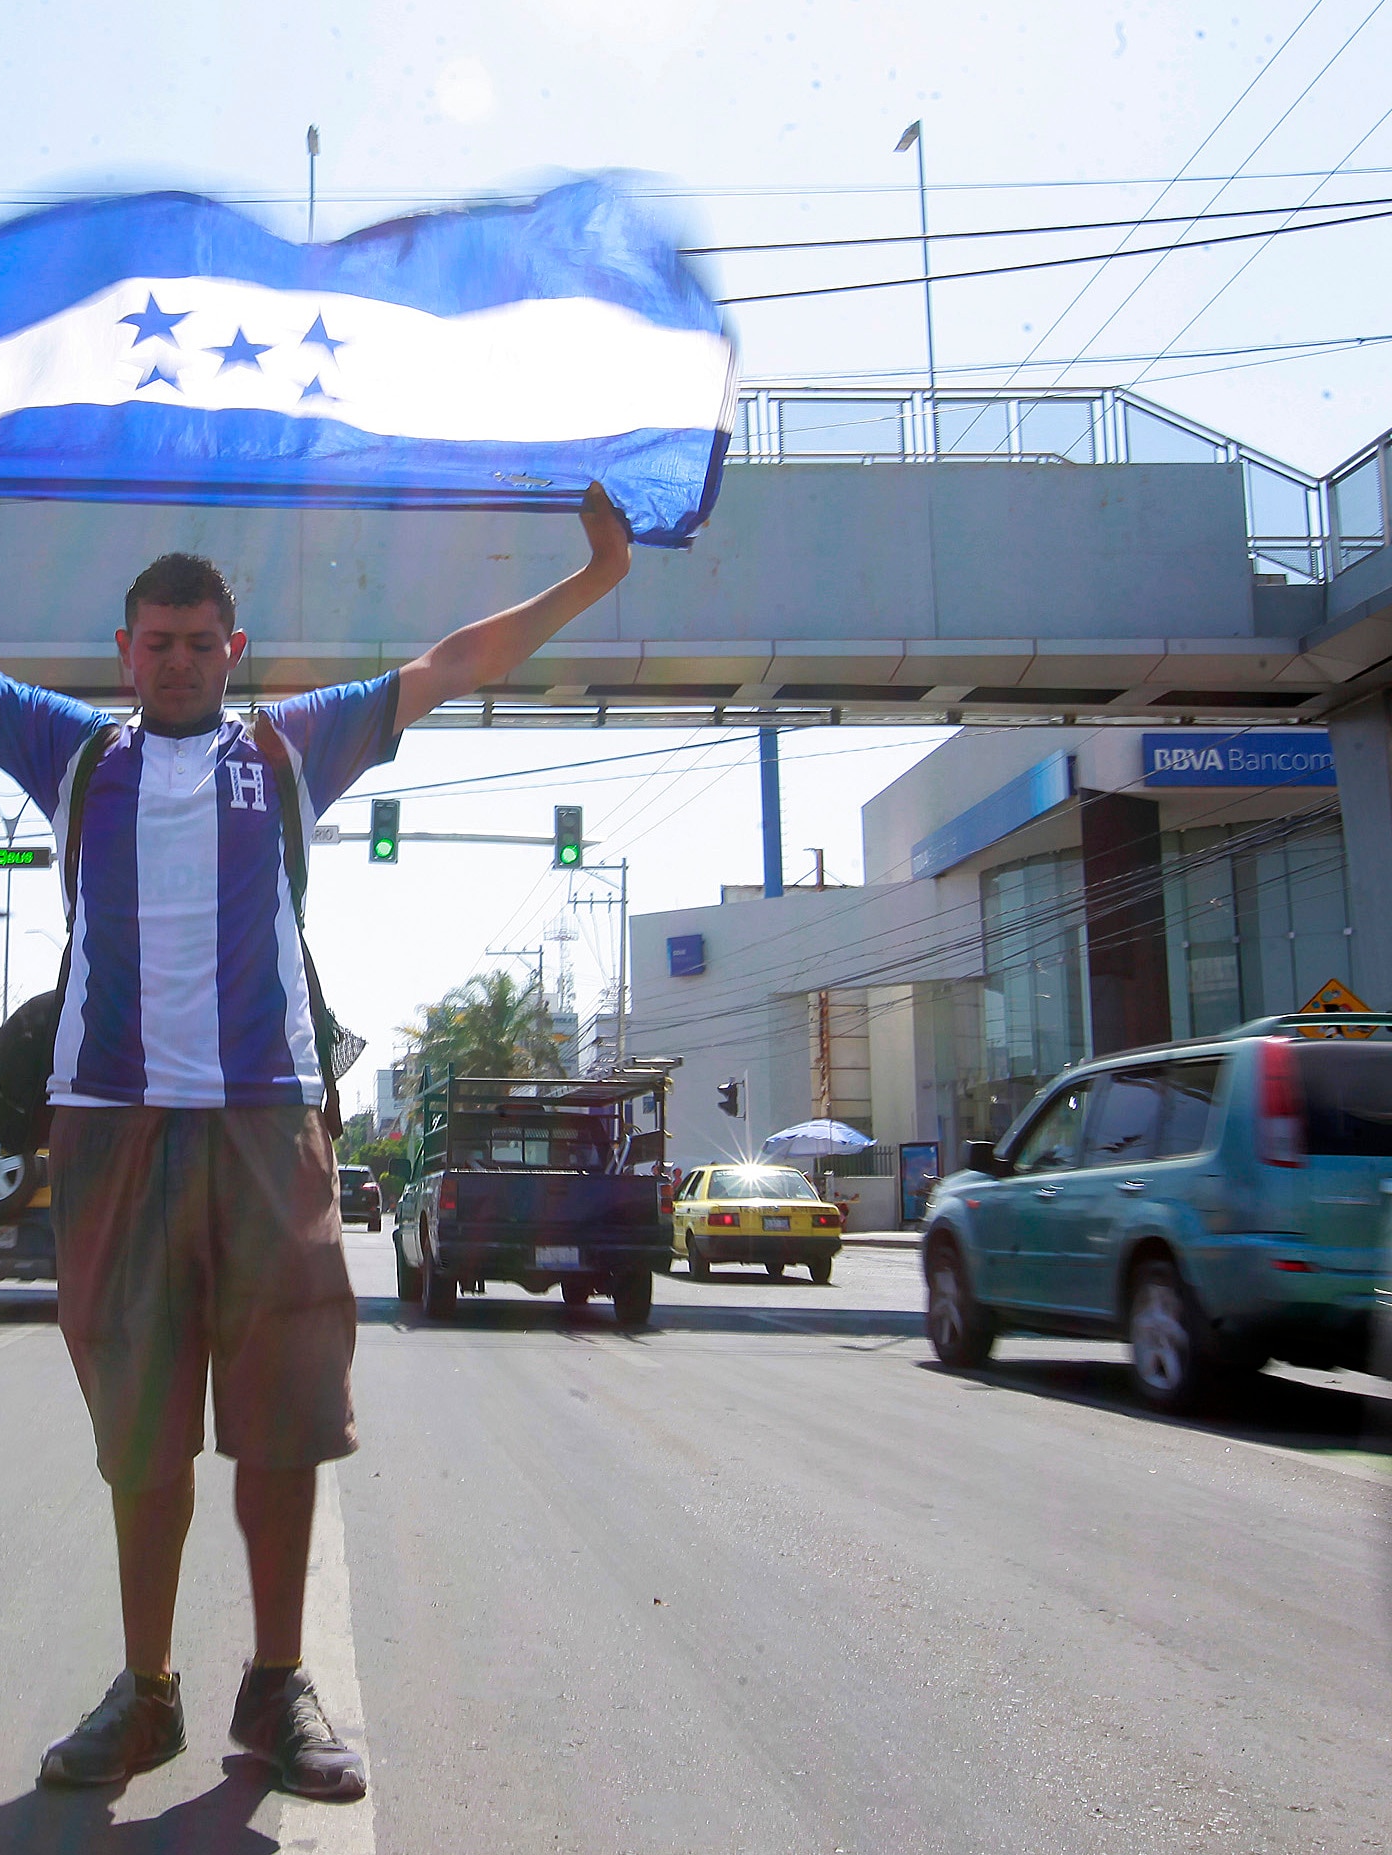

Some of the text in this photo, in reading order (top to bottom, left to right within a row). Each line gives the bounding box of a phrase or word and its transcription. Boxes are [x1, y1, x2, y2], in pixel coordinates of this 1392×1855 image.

[1154, 748, 1335, 771] BBVA Bancom
[225, 760, 267, 812] H
